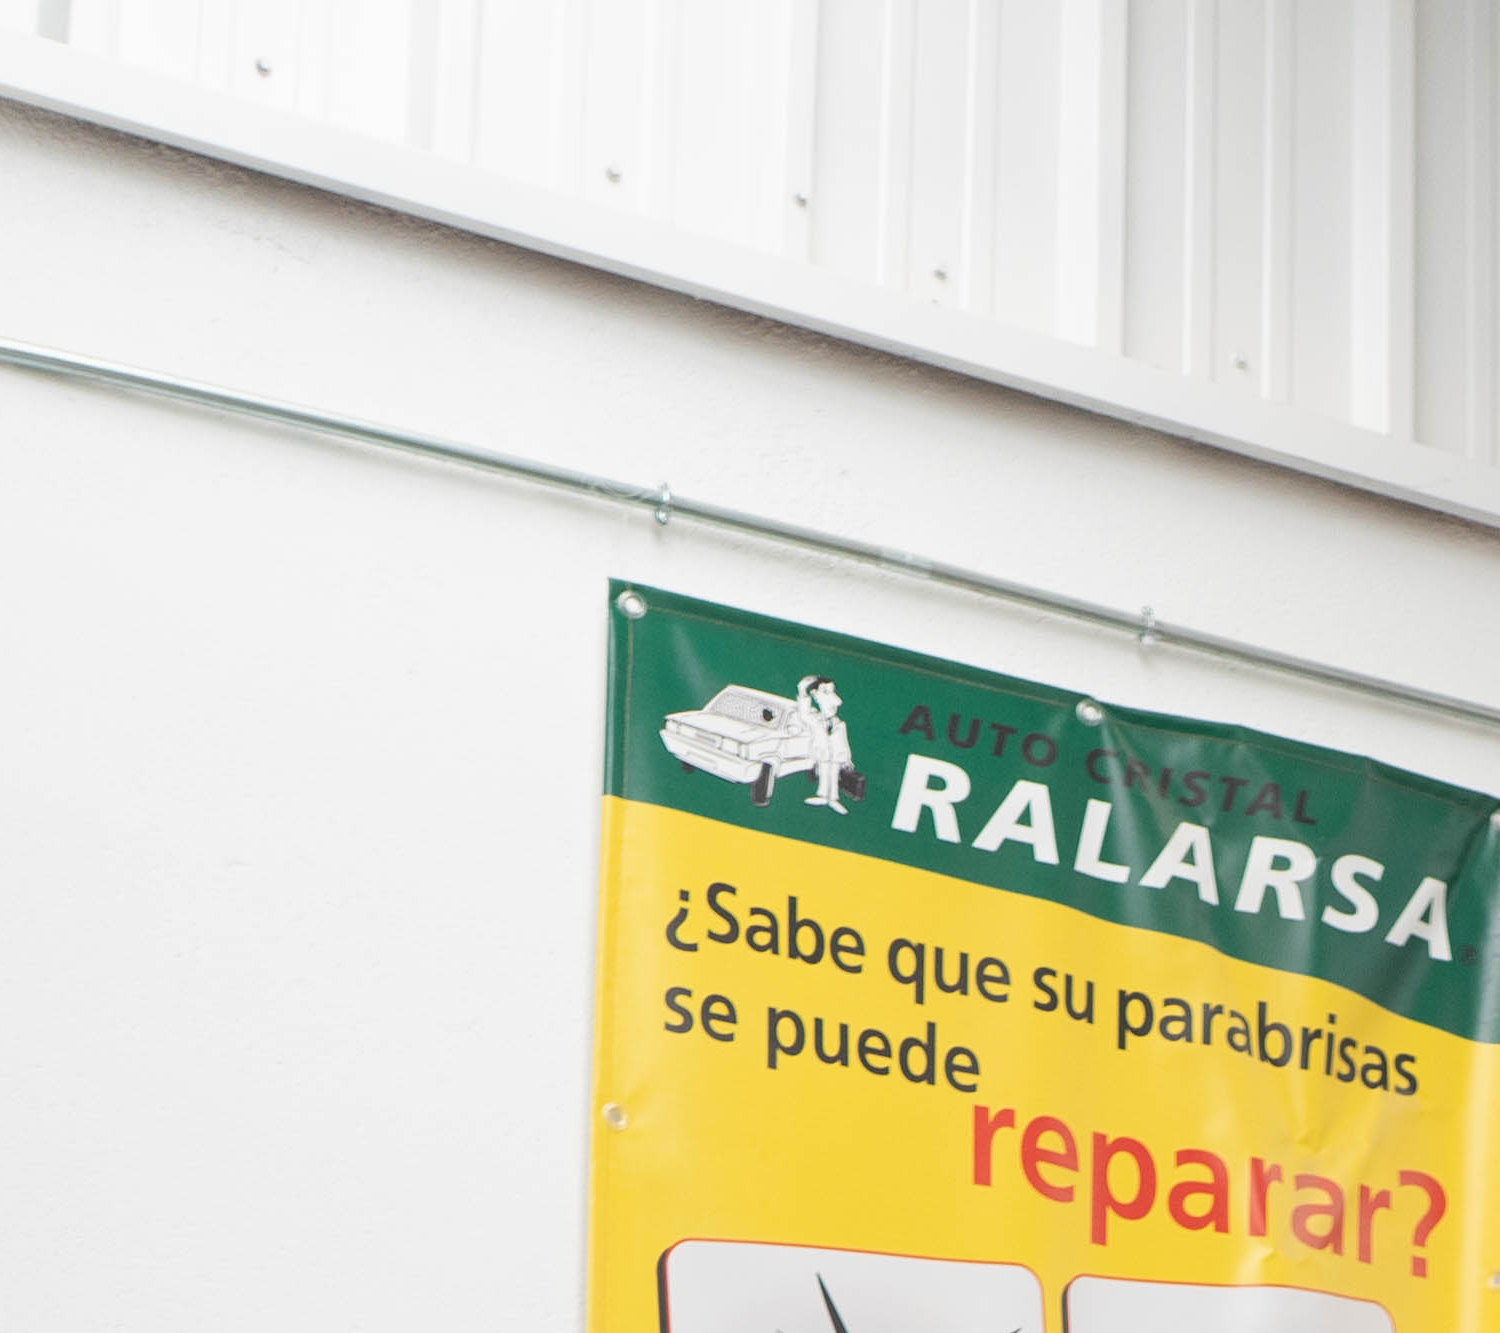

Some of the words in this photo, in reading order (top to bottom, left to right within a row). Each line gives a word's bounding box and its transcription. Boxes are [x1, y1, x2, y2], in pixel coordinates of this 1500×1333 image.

[900, 705, 1059, 768] AUTO
[1085, 749, 1319, 826] CRISTAL
[891, 755, 1454, 962] RALARSA
[665, 882, 866, 975] ¿Sabe
[888, 940, 1011, 1006] que
[1031, 967, 1095, 1024] su
[1117, 990, 1418, 1098] parabrisas
[665, 986, 737, 1043] se
[767, 1005, 981, 1094] puede
[972, 1105, 1449, 1278] reparar?
